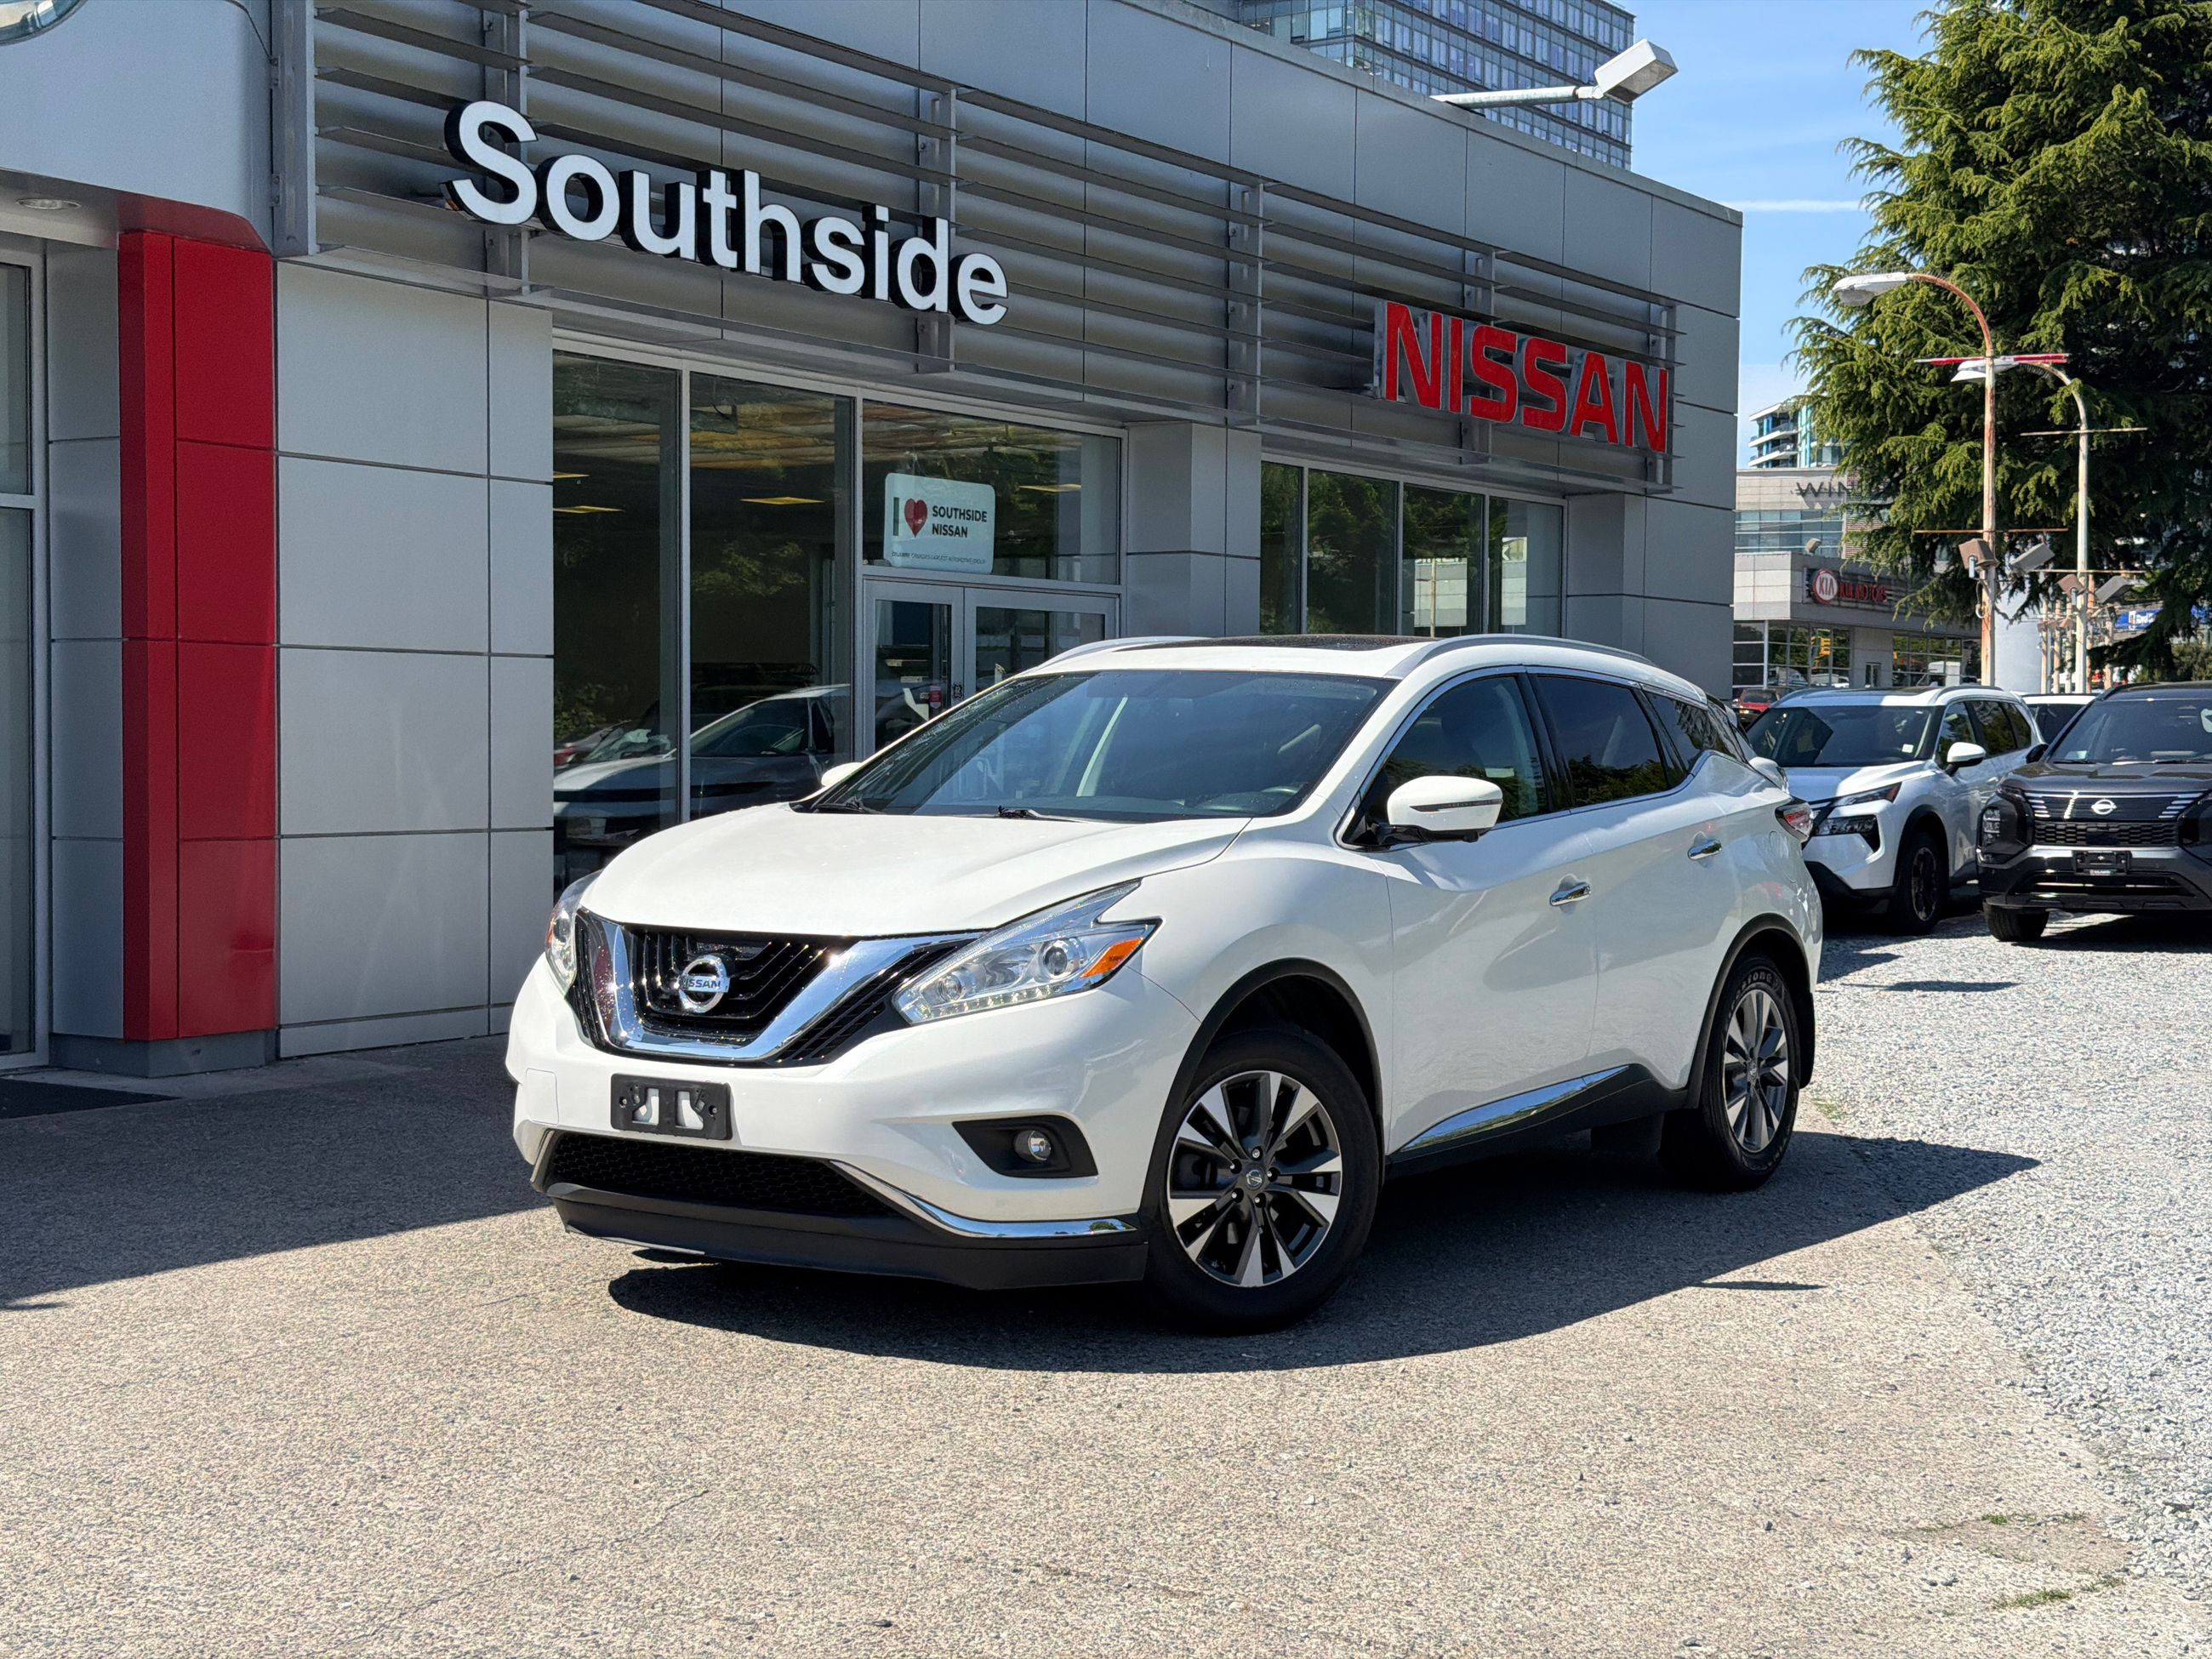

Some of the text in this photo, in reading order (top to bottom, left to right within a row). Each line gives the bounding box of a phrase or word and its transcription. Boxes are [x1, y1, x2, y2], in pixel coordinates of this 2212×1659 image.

[451, 100, 1009, 326] Southside
[1383, 300, 1668, 453] NISSAN
[932, 505, 988, 522] SOUTHSIDE
[932, 523, 968, 538] NISSAN
[1818, 578, 1835, 596] KIA
[681, 978, 721, 989] NISSAN
